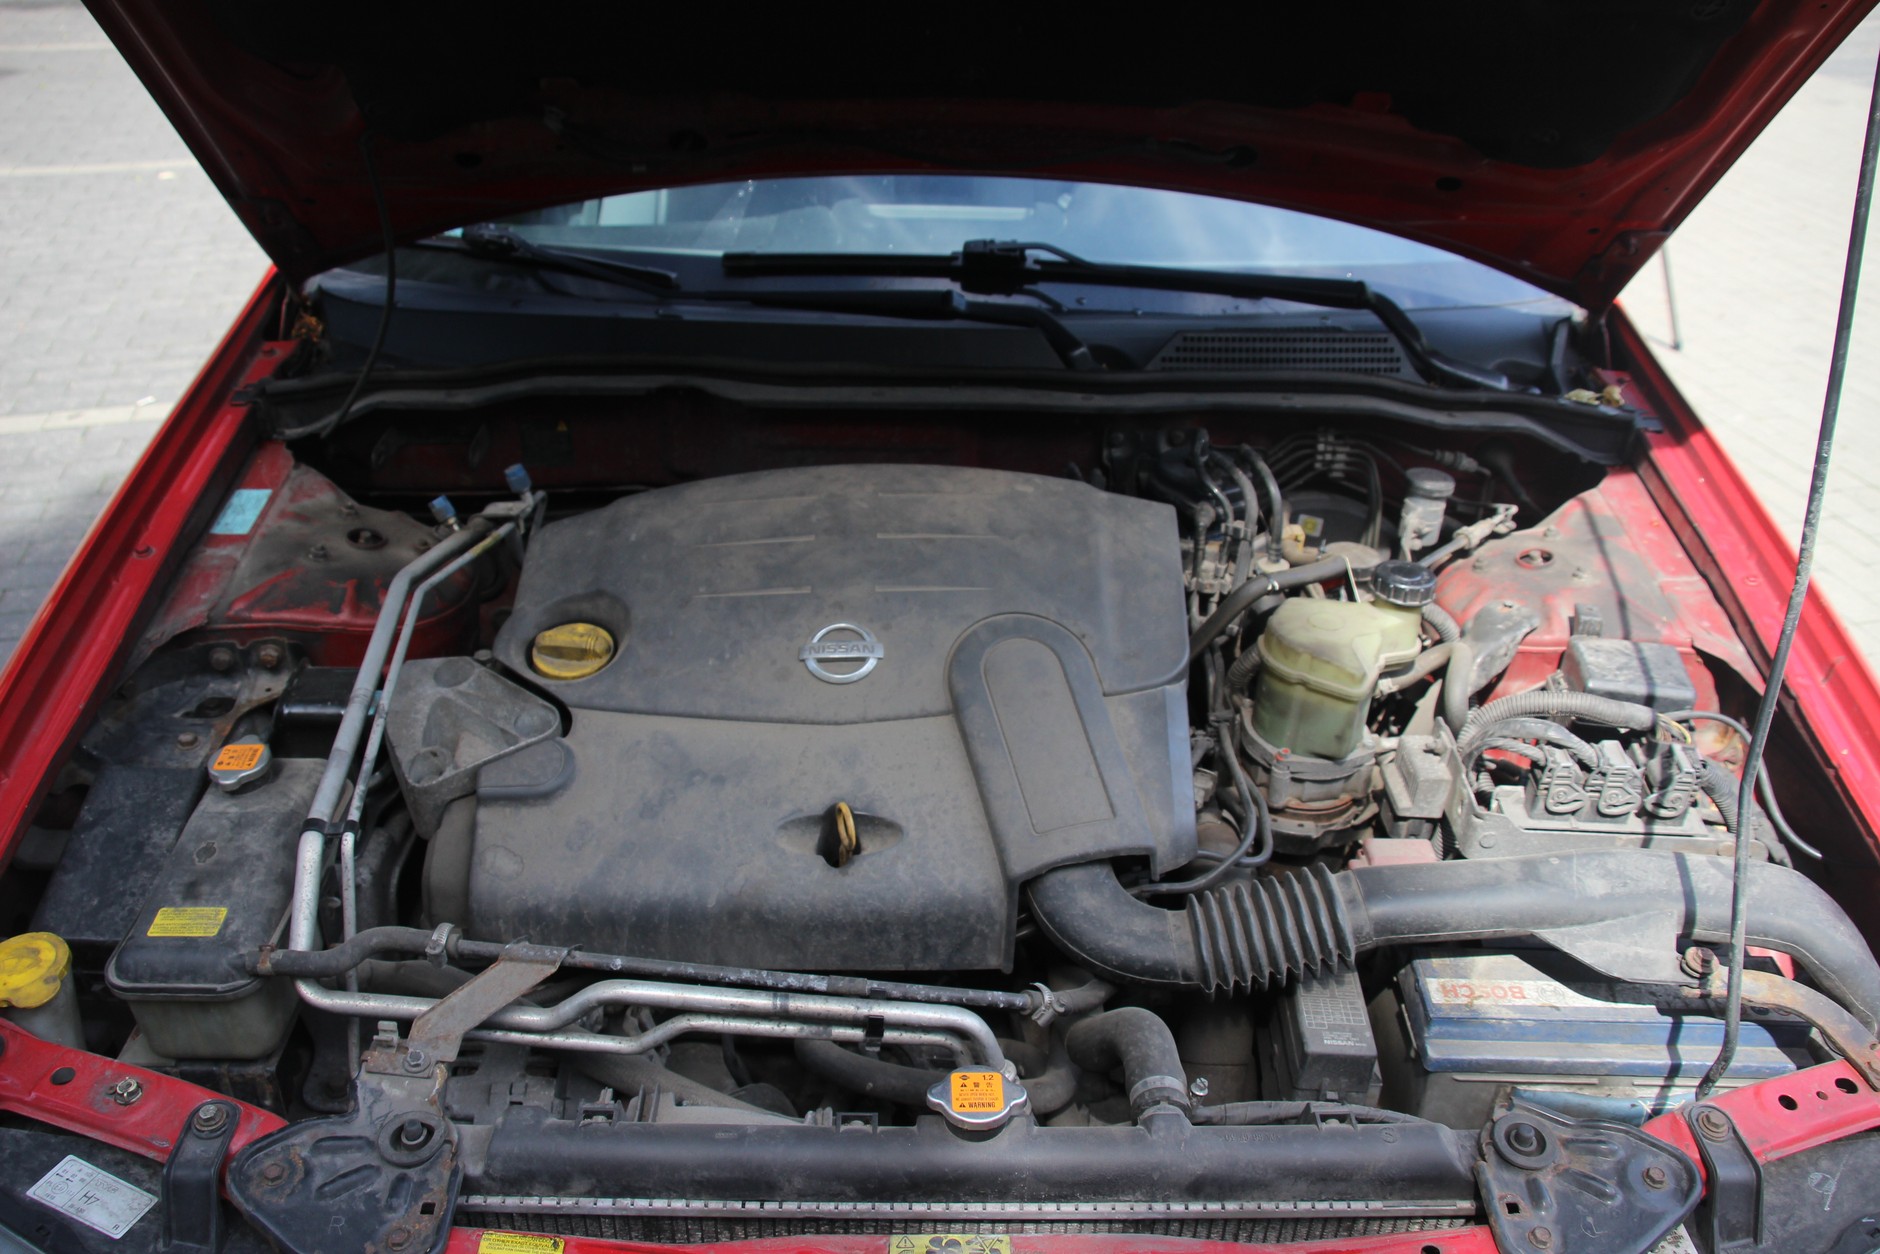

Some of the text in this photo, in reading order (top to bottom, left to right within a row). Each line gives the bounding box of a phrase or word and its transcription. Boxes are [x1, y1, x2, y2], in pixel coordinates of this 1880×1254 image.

[808, 644, 875, 654] NISSAN
[968, 1101, 996, 1109] WARNING
[78, 1190, 101, 1206] H7
